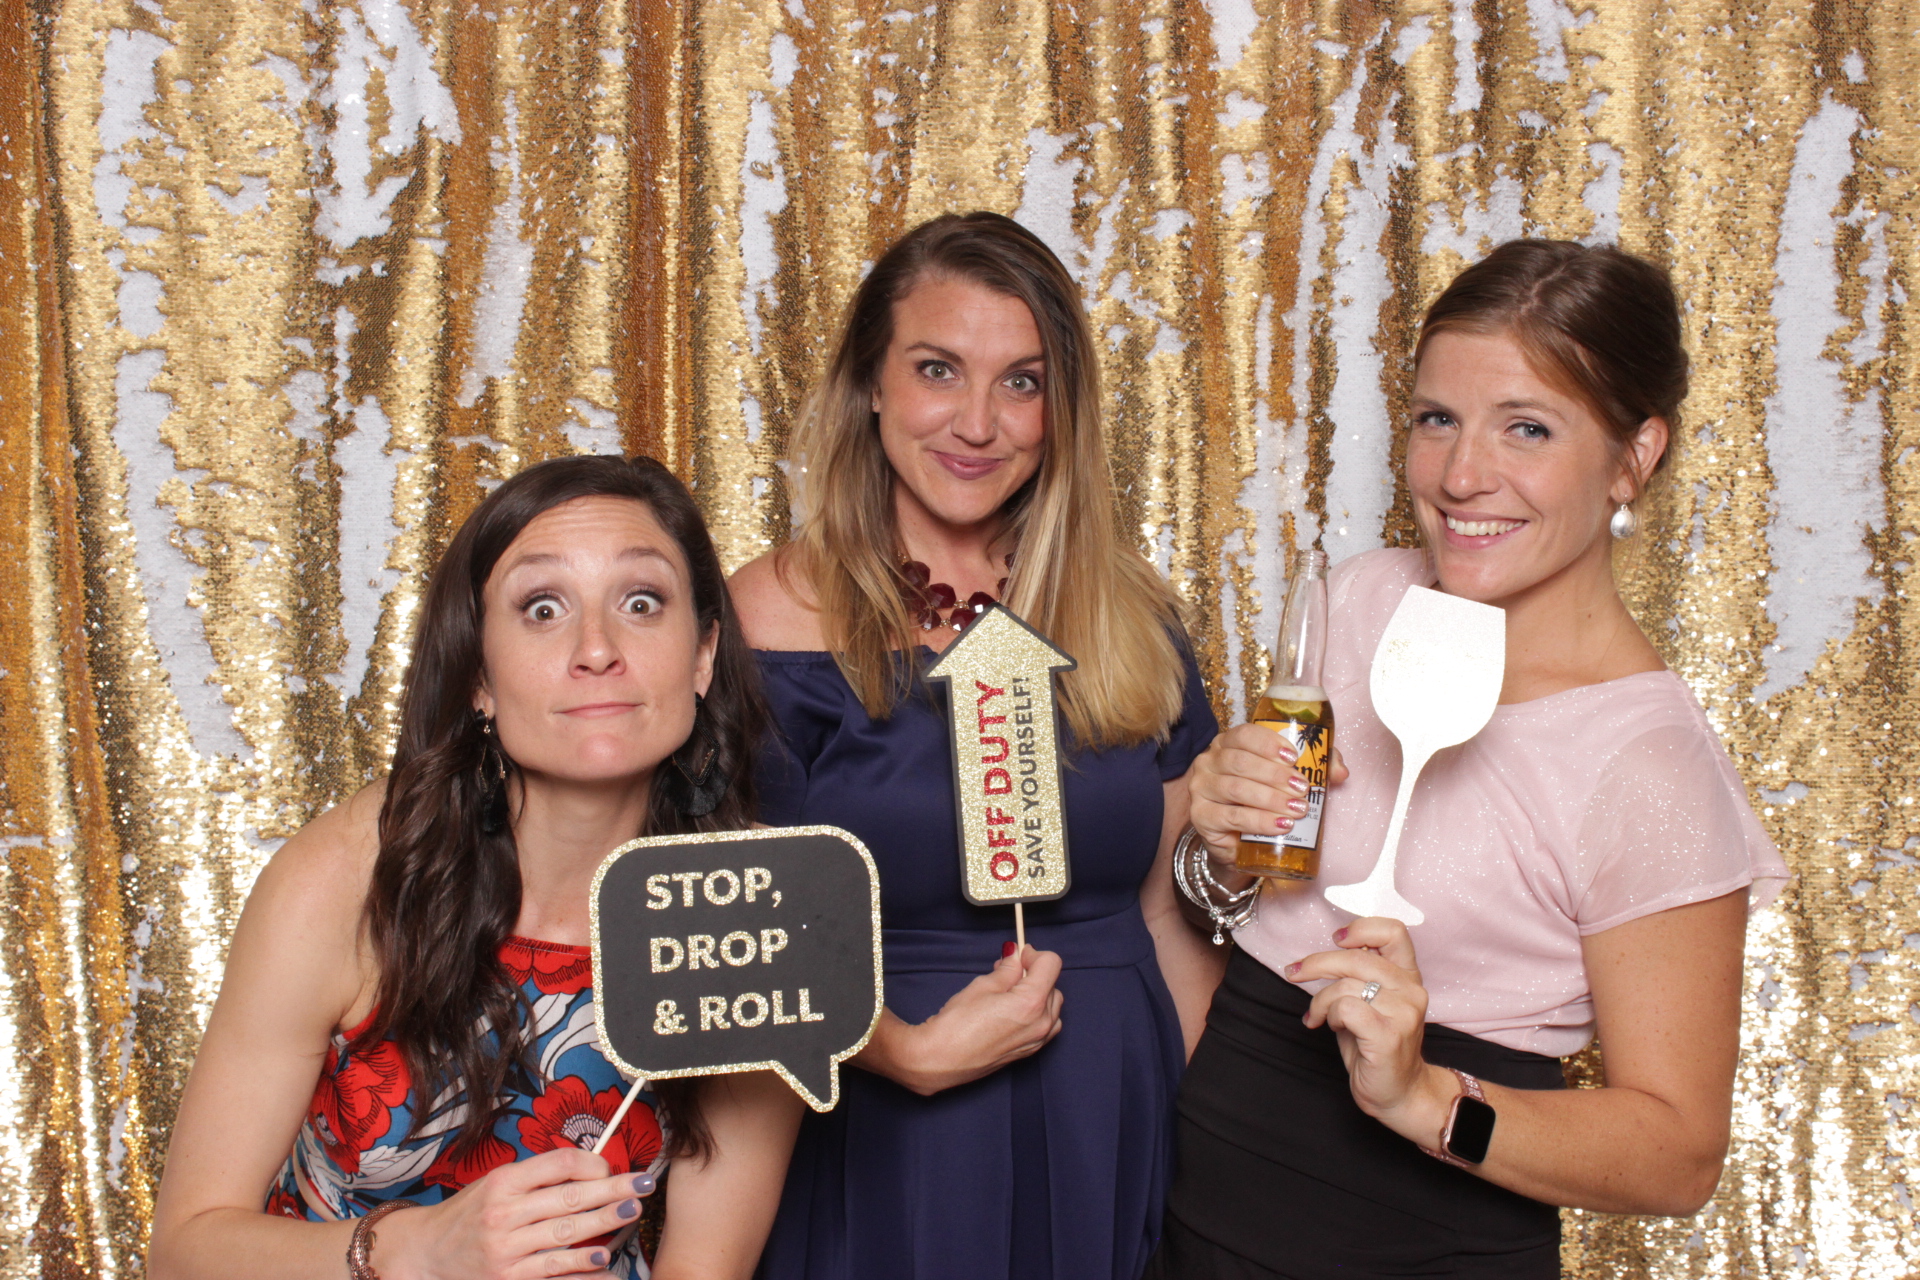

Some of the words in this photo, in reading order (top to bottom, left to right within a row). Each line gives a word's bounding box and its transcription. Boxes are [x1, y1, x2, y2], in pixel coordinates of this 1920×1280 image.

[975, 680, 1013, 796] DUTY
[1012, 676, 1040, 813] YOURSELF!
[986, 807, 1020, 882] OFF
[1021, 817, 1046, 879] SAVE
[646, 867, 783, 910] STOP,
[650, 928, 789, 974] DROP
[653, 999, 690, 1036] &
[699, 988, 825, 1032] ROLL
